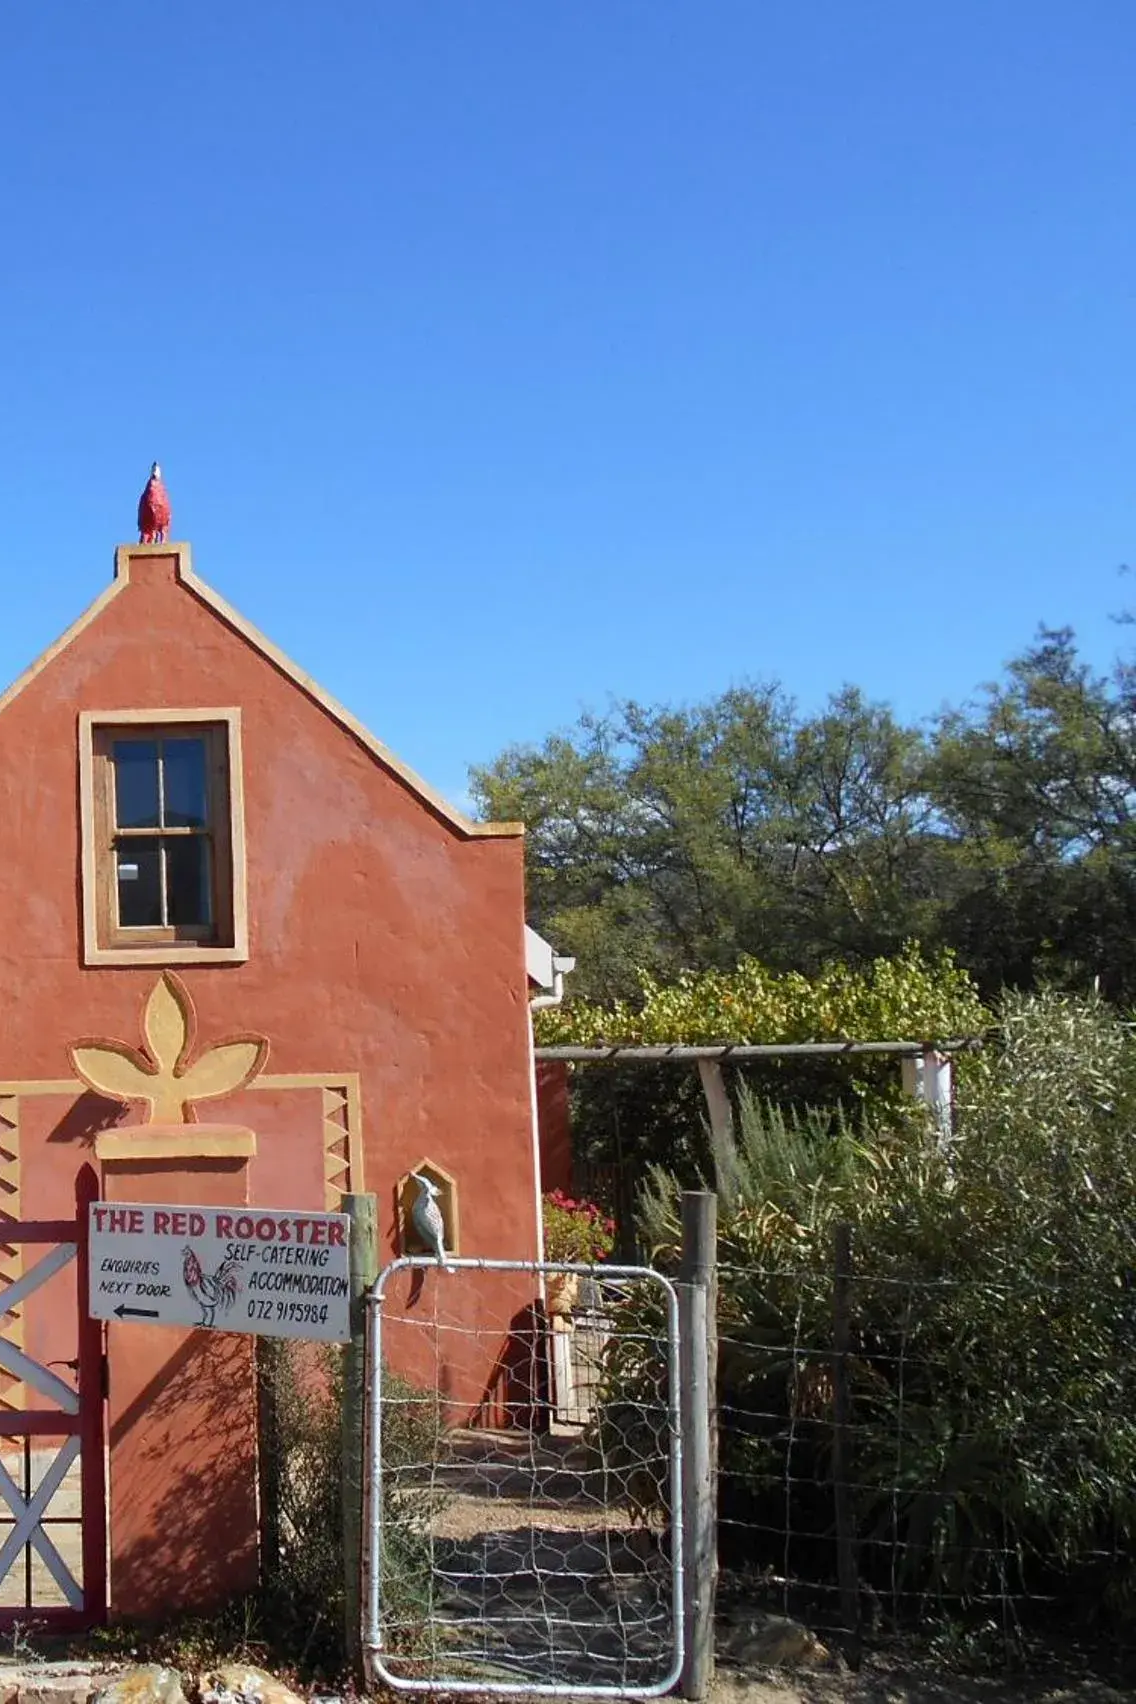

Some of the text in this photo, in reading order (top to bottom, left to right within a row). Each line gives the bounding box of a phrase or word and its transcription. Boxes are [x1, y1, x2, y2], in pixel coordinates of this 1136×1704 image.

[93, 1209, 347, 1246] THE RED ROOSTER
[224, 1243, 330, 1267] SELF-CATERING
[100, 1258, 160, 1275] ENQUIRIES
[98, 1280, 172, 1297] NEXT DOOR
[248, 1271, 349, 1297] ACCOMMODATION
[247, 1299, 273, 1320] 072
